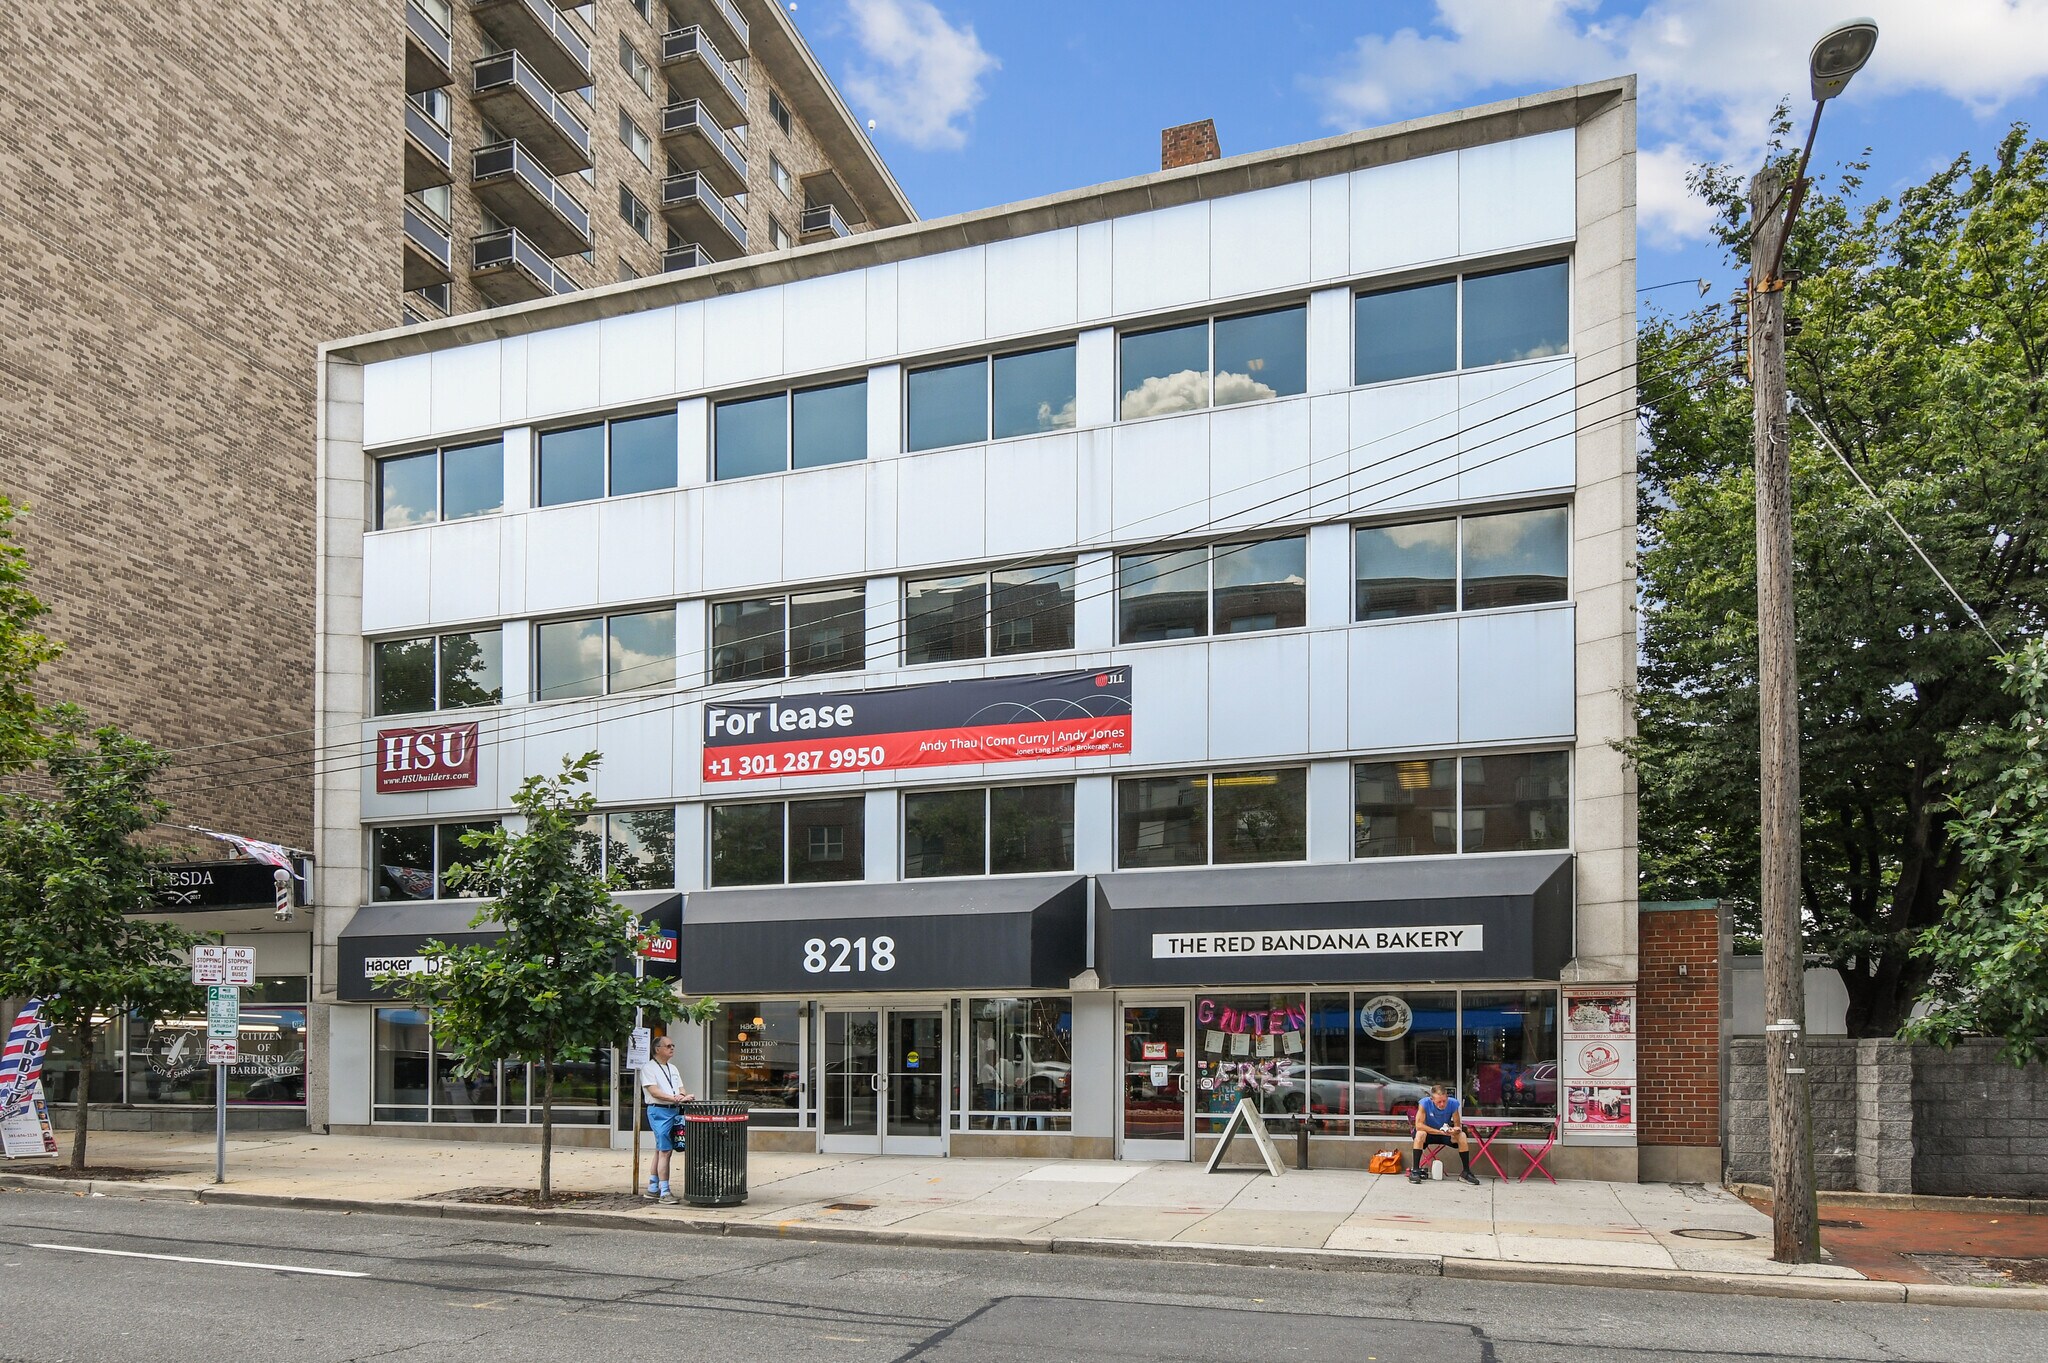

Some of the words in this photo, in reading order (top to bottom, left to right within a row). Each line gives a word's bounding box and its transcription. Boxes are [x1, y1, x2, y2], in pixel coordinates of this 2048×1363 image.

[1108, 675, 1125, 684] JLL
[708, 709, 761, 737] For
[769, 703, 854, 732] lease
[920, 740, 947, 752] Andy
[950, 738, 977, 749] Thau
[986, 736, 1014, 746] Conn
[1018, 734, 1049, 745] Curry
[1058, 729, 1086, 742] Andy
[1090, 728, 1125, 740] Jones
[383, 730, 469, 772] HSU
[1016, 748, 1034, 756] Jones
[1035, 747, 1051, 755] Lang
[708, 758, 733, 776] +1
[738, 754, 777, 776] 301
[783, 750, 824, 772] 287
[829, 746, 885, 769] 9950
[383, 772, 469, 784] www.HSUbuilders.com
[1168, 938, 1207, 954] THE
[1214, 937, 1256, 952] RED
[1262, 934, 1370, 951] BANDANA
[1376, 930, 1464, 948] BAKERY
[204, 948, 214, 956] NO
[802, 936, 896, 974] 8218
[210, 988, 217, 999] 2
[241, 1032, 282, 1040] CITIZEN
[257, 1043, 272, 1052] OF
[152, 1064, 166, 1076] CUT
[174, 1064, 195, 1078] SHAVE
[230, 1066, 298, 1074] BARBERSHOP
